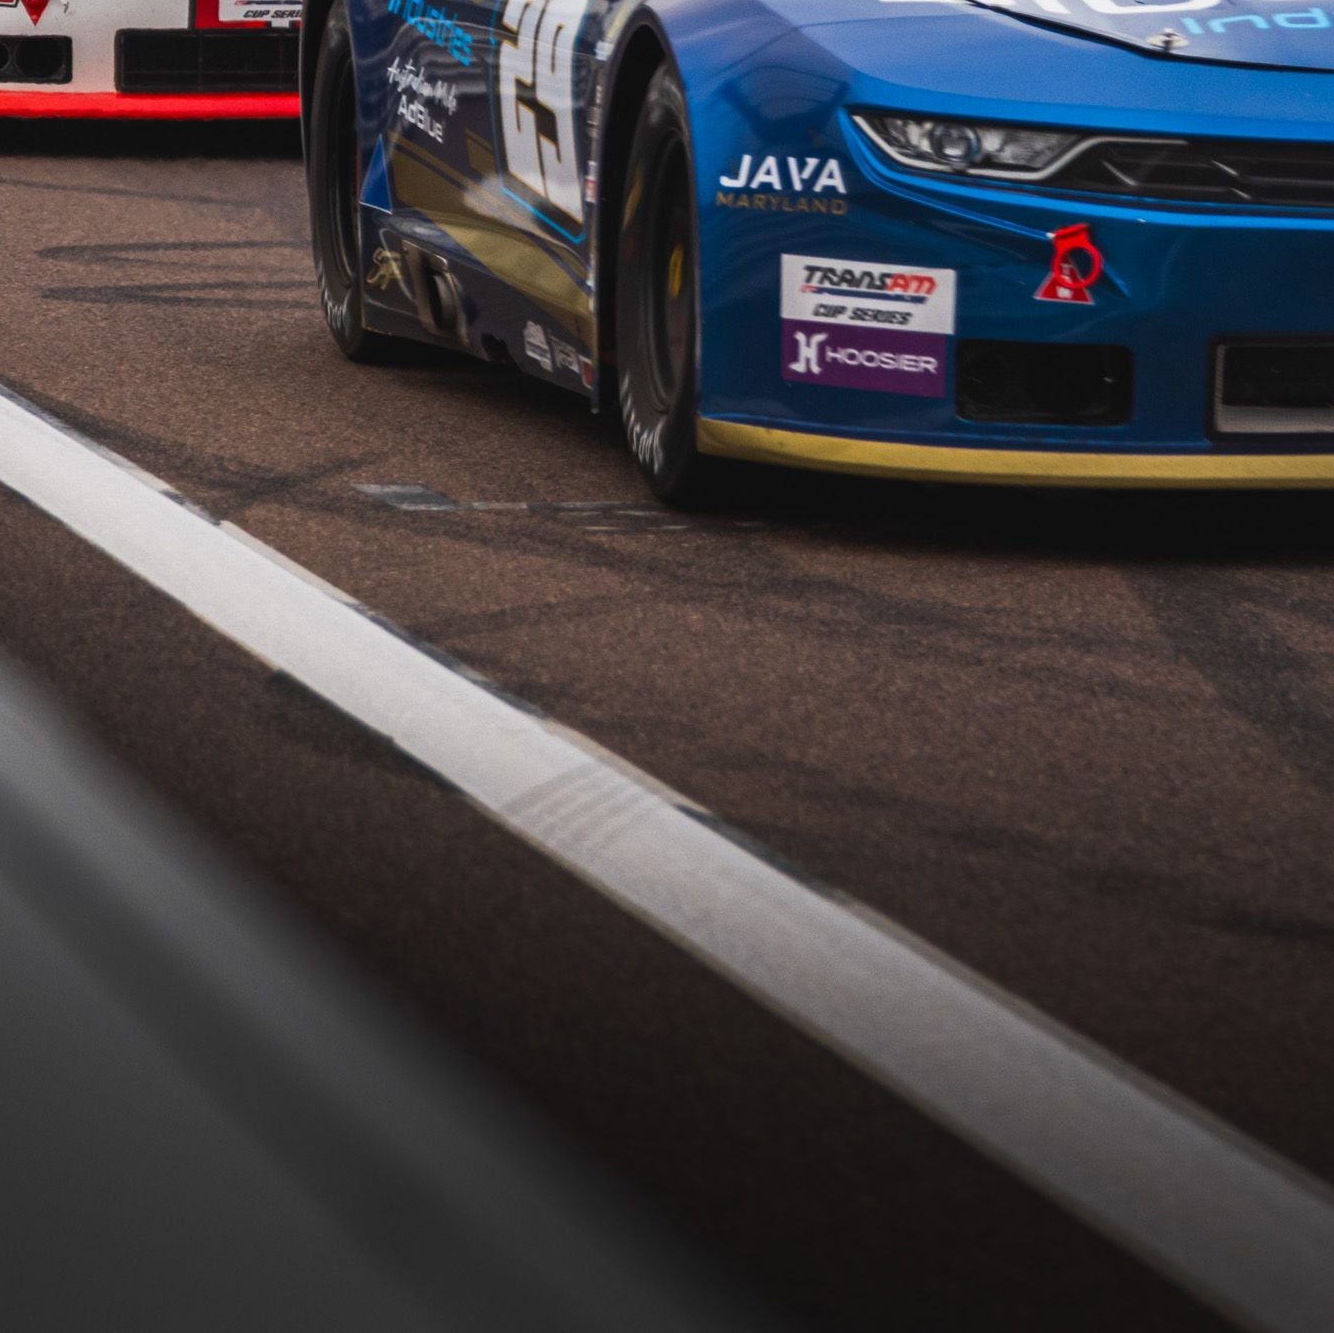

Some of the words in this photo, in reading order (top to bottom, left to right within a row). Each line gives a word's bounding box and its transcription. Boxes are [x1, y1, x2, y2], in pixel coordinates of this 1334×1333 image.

[243, 9, 270, 18] CUP
[270, 9, 303, 19] SERI
[397, 94, 445, 144] AdBlue
[719, 154, 849, 194] JAVA
[714, 191, 849, 216] MARYLAND
[812, 302, 847, 318] CUP
[849, 306, 914, 325] SERIES
[824, 345, 939, 374] HOOSIER
